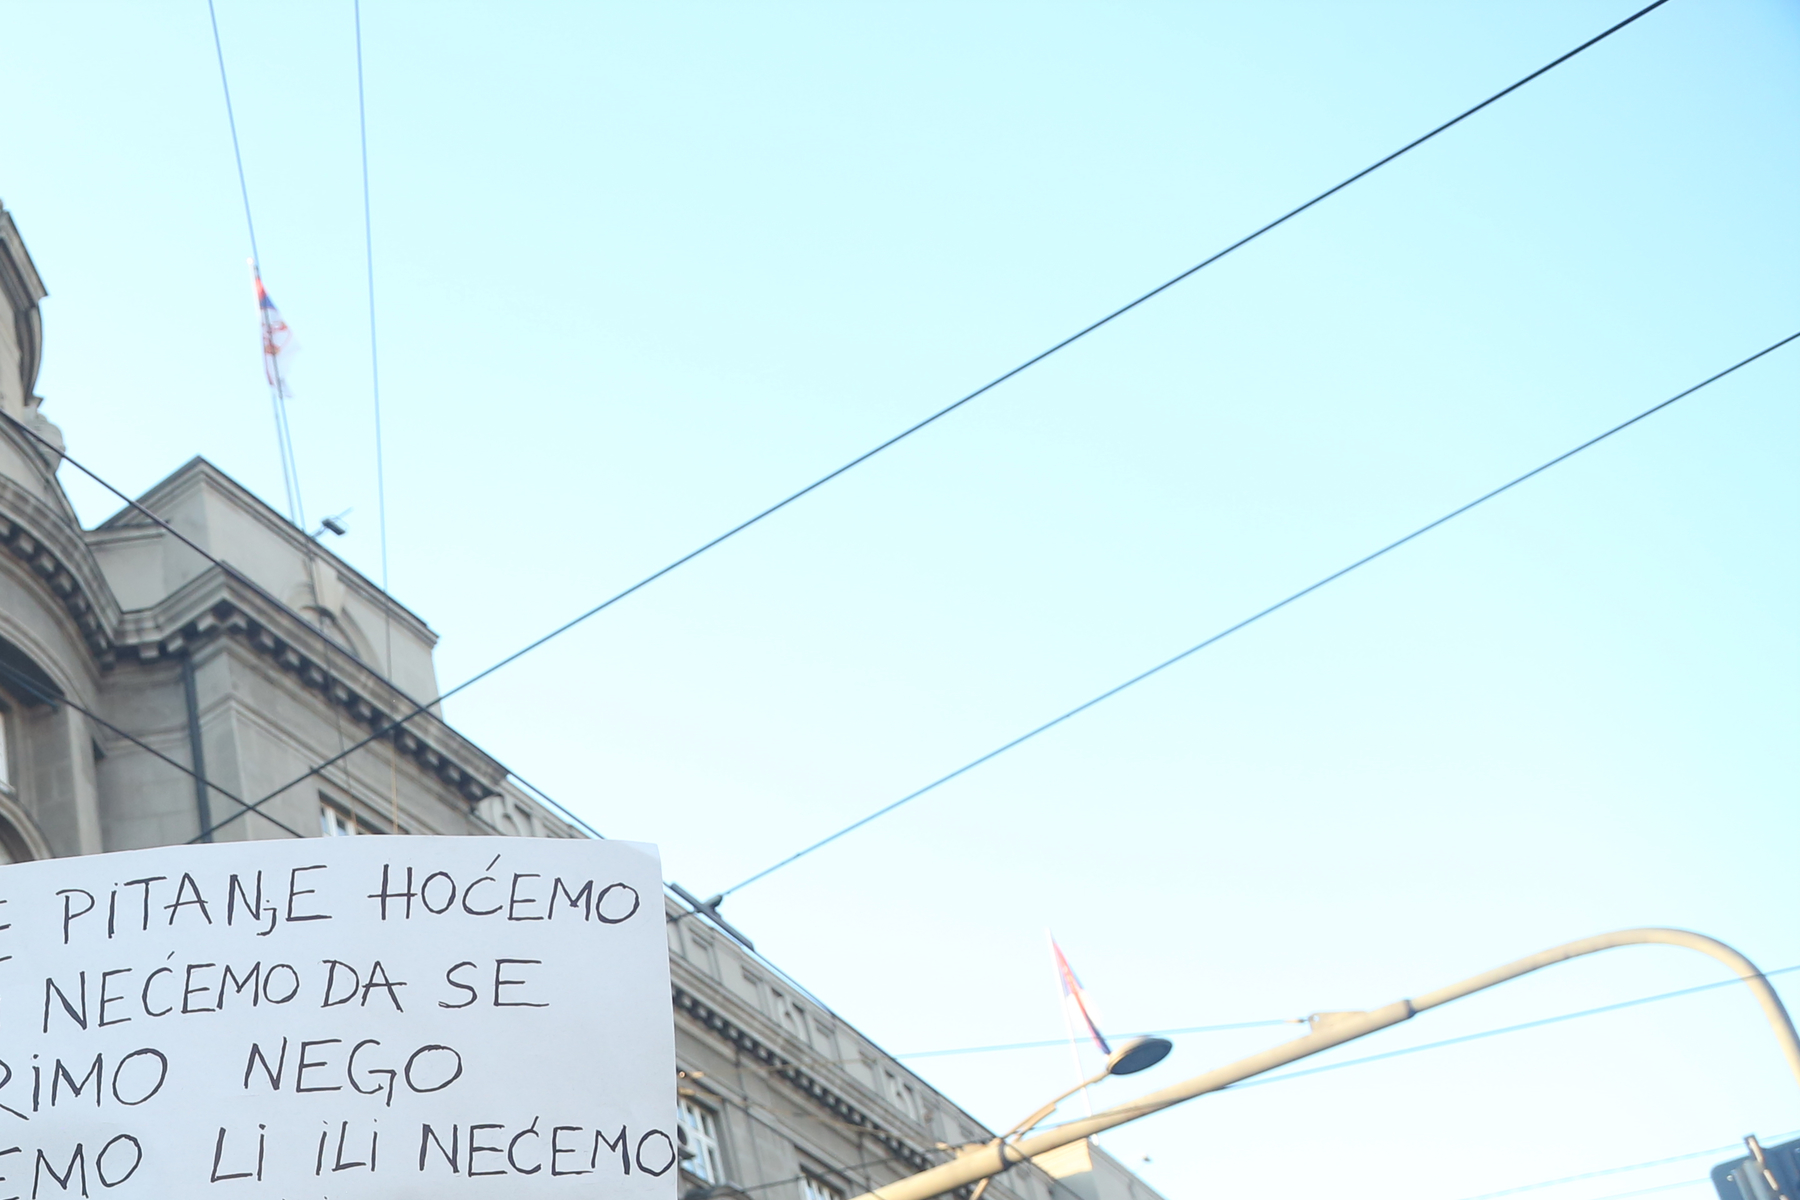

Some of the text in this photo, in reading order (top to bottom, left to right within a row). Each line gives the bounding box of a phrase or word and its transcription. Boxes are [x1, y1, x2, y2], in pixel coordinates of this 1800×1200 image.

[367, 854, 640, 924] HOĆEMO
[43, 951, 300, 1033] NEĆEMO
[321, 960, 407, 1013] DA
[438, 959, 549, 1008] SE
[244, 1037, 462, 1107] NEGO
[419, 1116, 676, 1177] NEĆEMO
